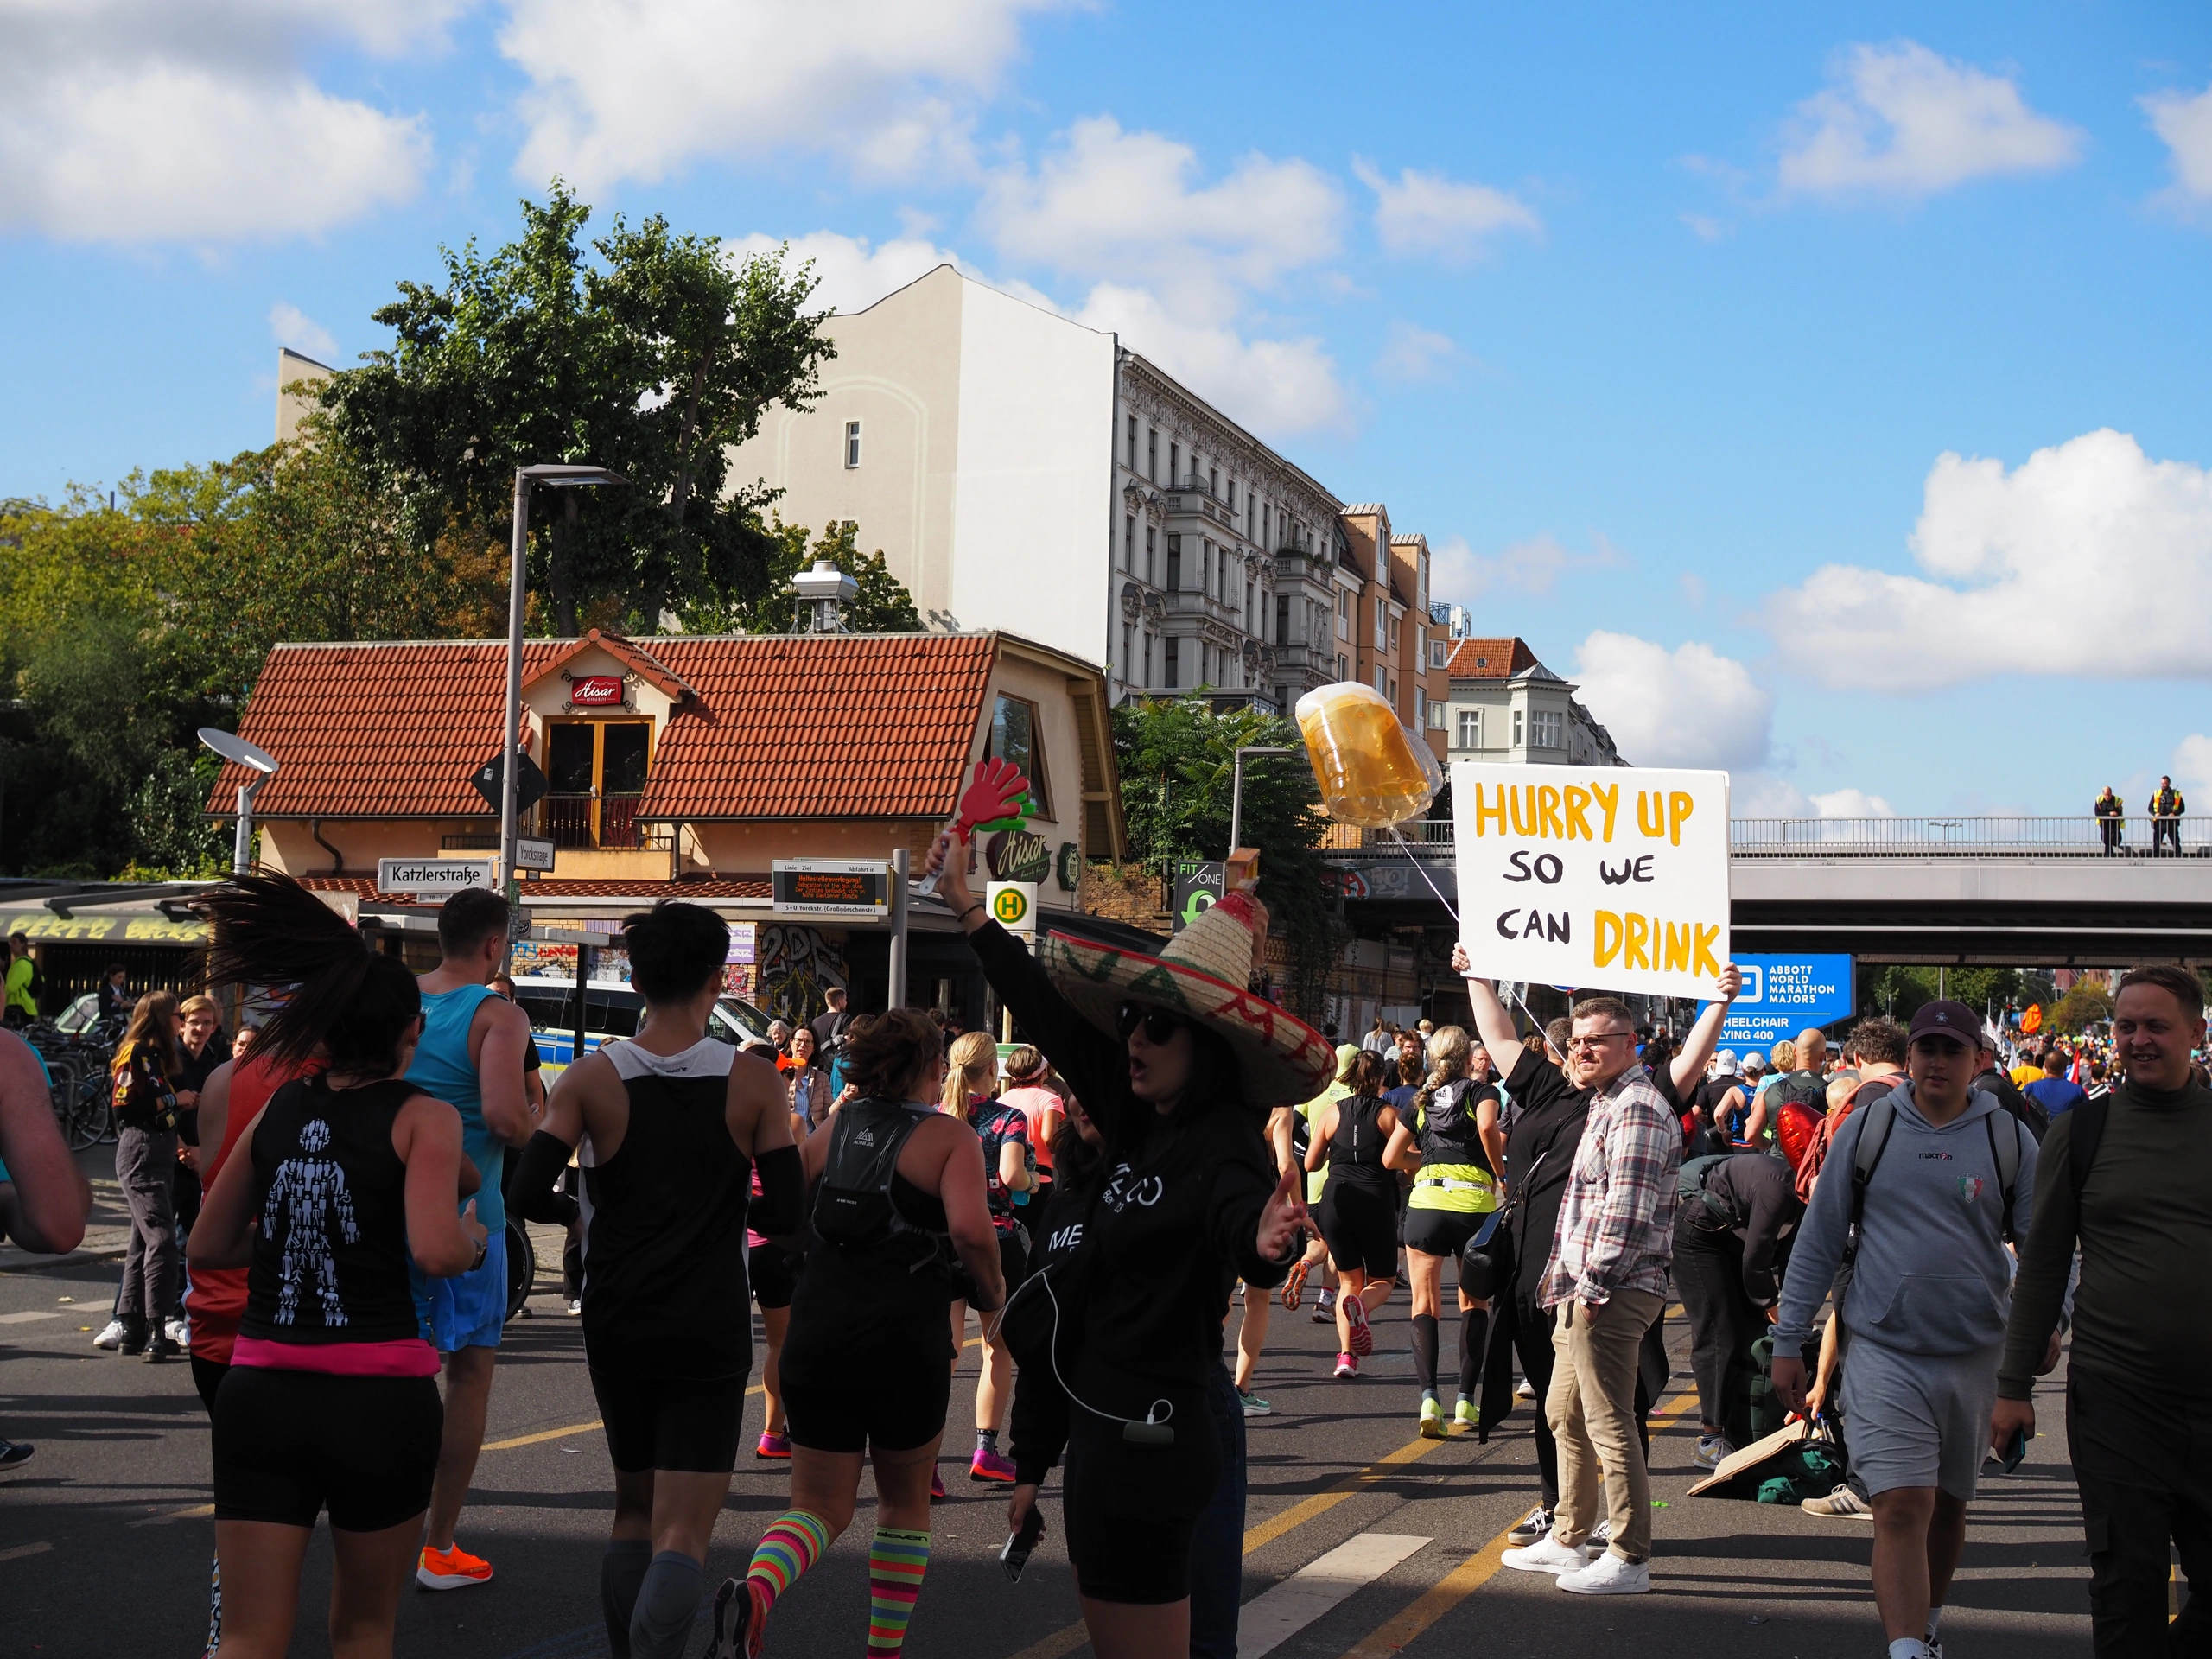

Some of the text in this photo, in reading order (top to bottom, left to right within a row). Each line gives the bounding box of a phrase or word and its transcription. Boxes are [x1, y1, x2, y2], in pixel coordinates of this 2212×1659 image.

[575, 680, 615, 698] Hisar
[1475, 781, 1694, 846] HURRY UP
[520, 844, 548, 865] Yorckstraße
[997, 830, 1047, 876] Hisar
[1179, 864, 1198, 874] FIT
[1503, 850, 1655, 885] SO WE
[392, 866, 480, 885] Katzlerstraße
[798, 874, 861, 884] Haltestellenverlegung!
[1198, 874, 1222, 885] ONE
[1002, 896, 1018, 916] H
[1496, 908, 1720, 978] CAN DRINK
[1769, 965, 1813, 975] ABBOTT
[1770, 975, 1809, 984] WORLD
[1769, 985, 1835, 995] MARATHON
[1769, 995, 1816, 1004] MAJORS
[1723, 1017, 1789, 1027] HEELCHAIR
[1752, 1031, 1774, 1040] 400
[1918, 1152, 1953, 1160] macron
[876, 1531, 928, 1542] eleven
